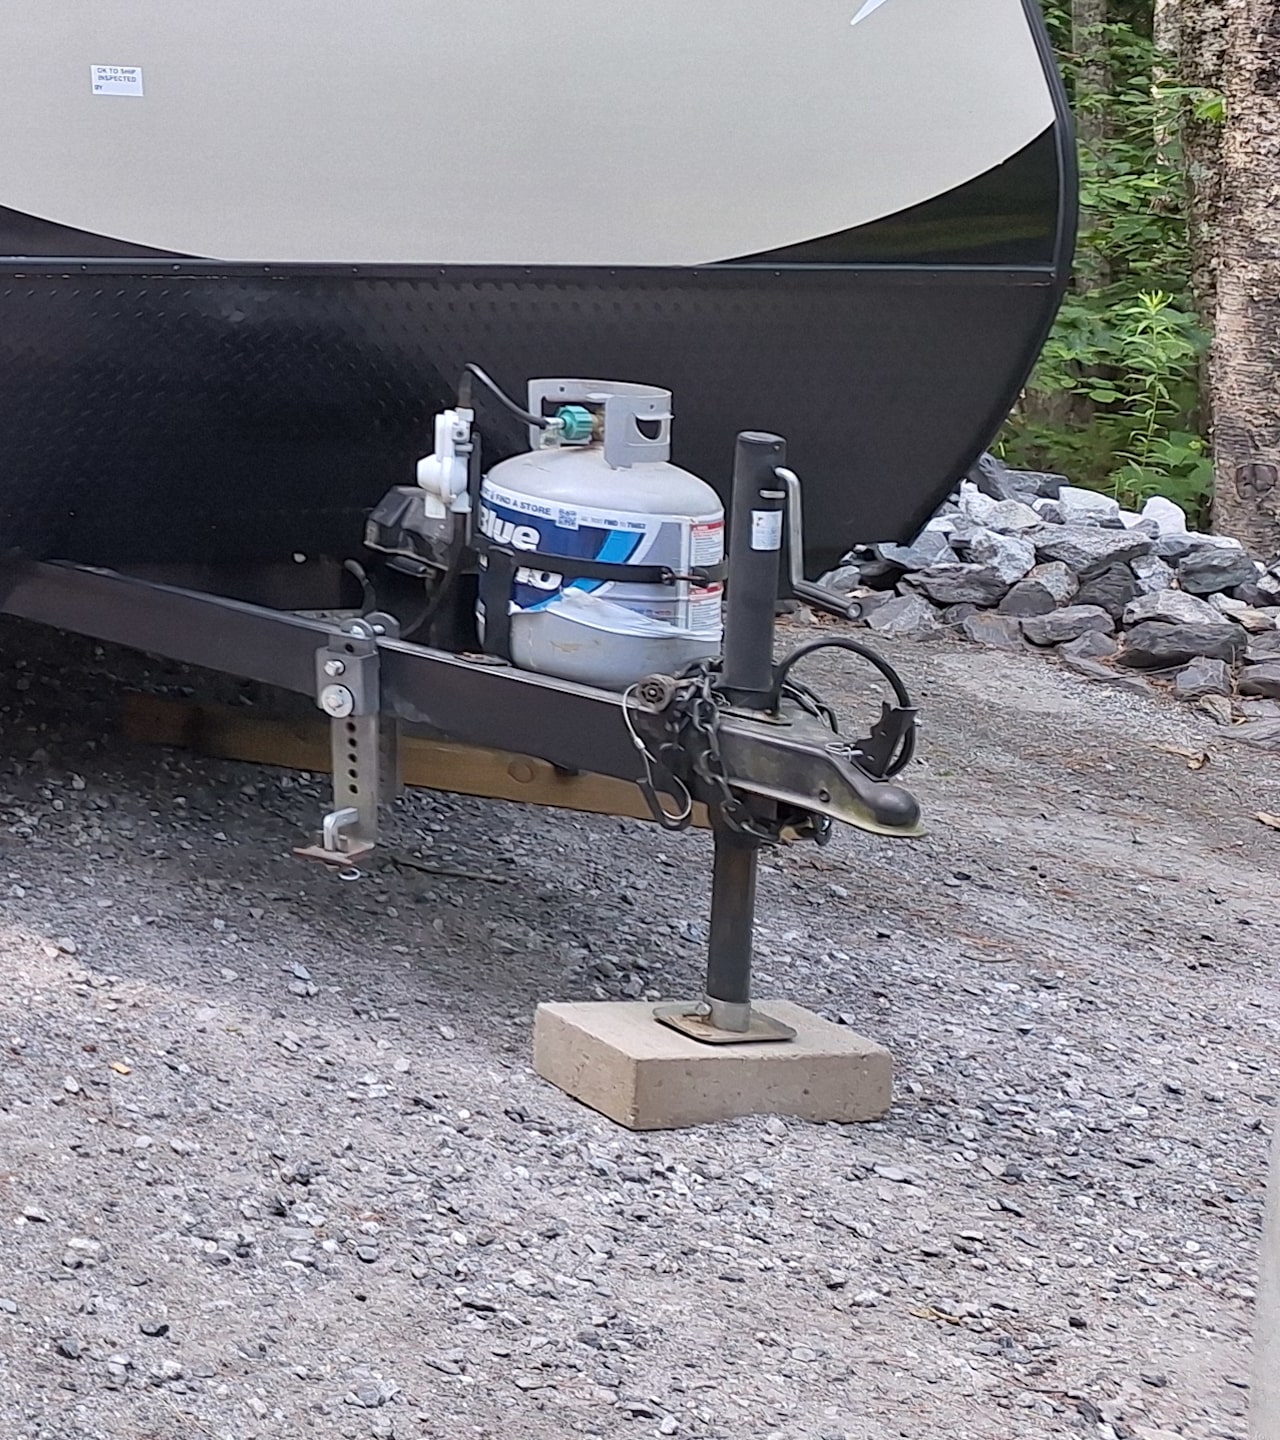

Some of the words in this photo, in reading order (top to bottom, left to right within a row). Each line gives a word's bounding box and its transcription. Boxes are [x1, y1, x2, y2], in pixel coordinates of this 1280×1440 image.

[495, 493, 512, 505] FIND
[512, 499, 519, 507] A
[519, 501, 553, 516] STORE
[478, 504, 541, 552] Blue
